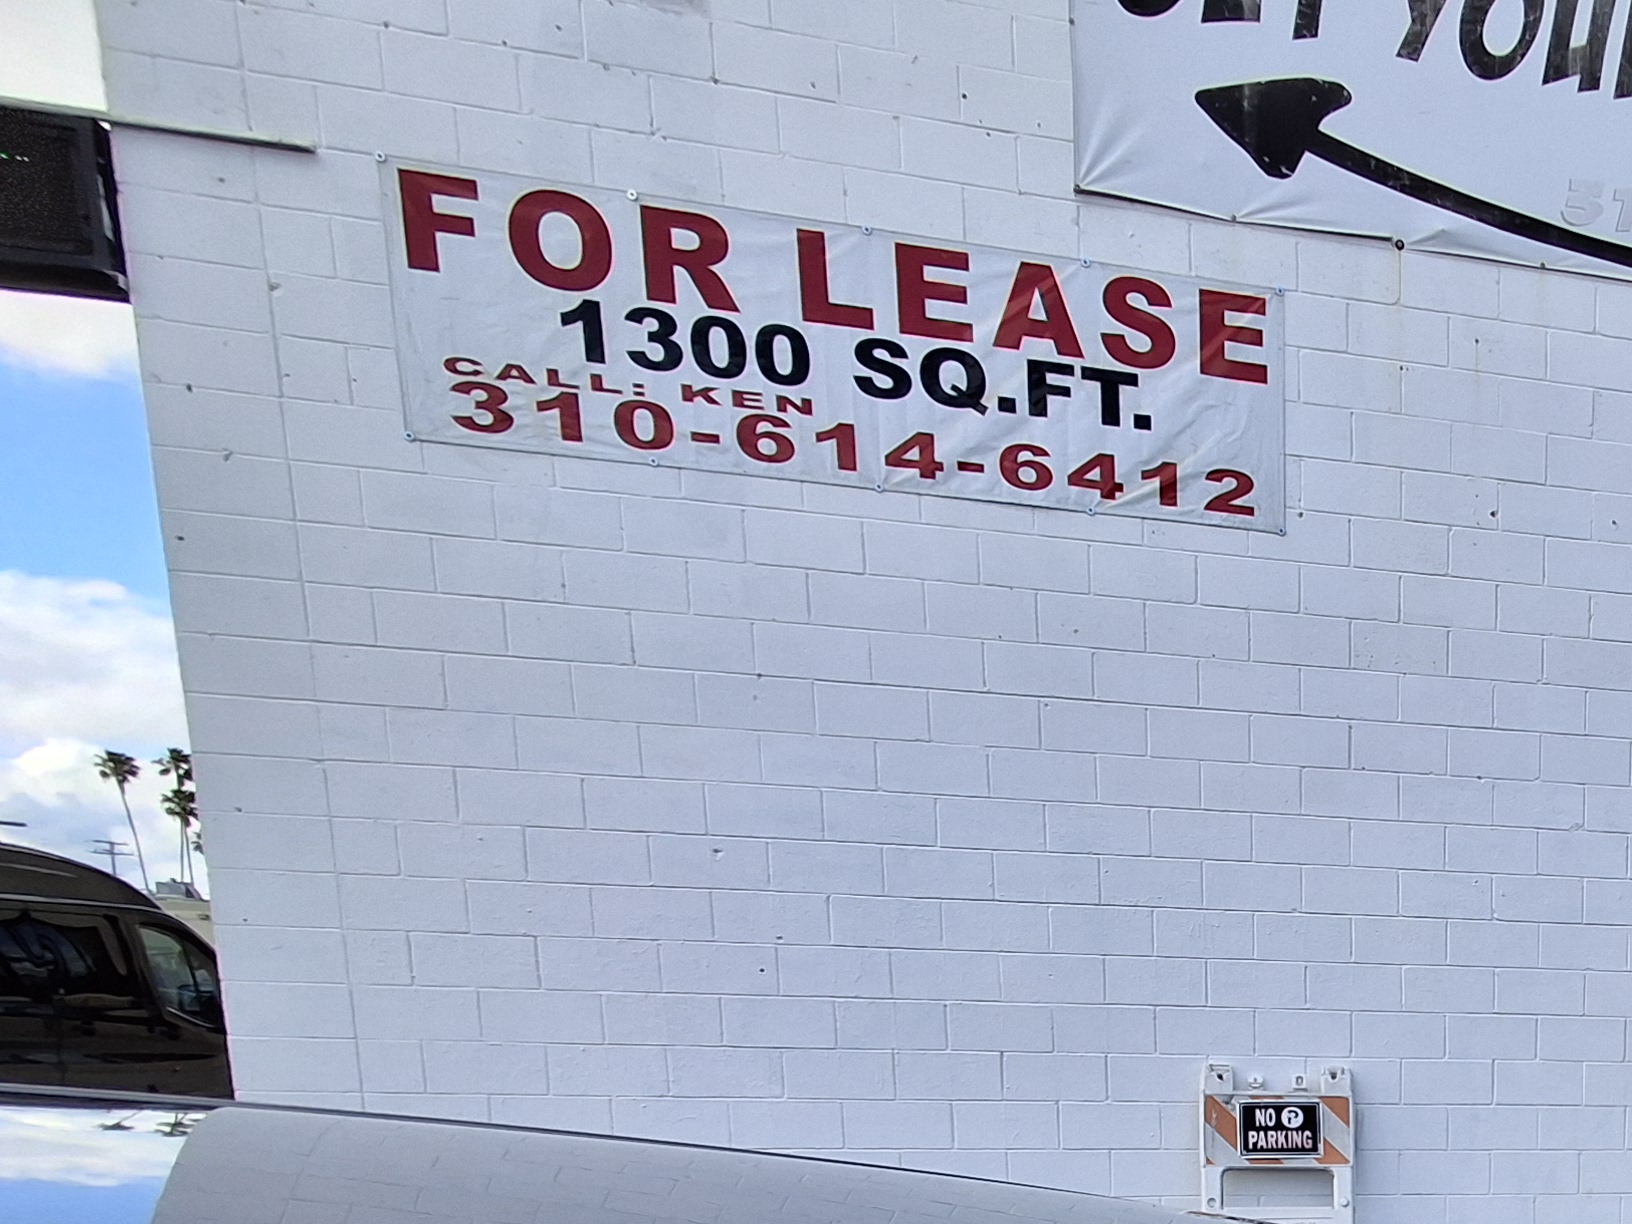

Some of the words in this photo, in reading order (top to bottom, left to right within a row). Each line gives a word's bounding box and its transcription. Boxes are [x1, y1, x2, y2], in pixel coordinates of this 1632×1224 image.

[396, 168, 739, 313] FOR
[796, 228, 1270, 386] LEASE
[443, 356, 646, 396] CALL:
[680, 384, 813, 416] KEN
[559, 299, 811, 386] 1300
[853, 337, 1152, 431] SQ.FT.
[450, 381, 1255, 516] 310-614-6412
[1248, 1130, 1313, 1149] PARKING
[1255, 1108, 1276, 1127] NO
